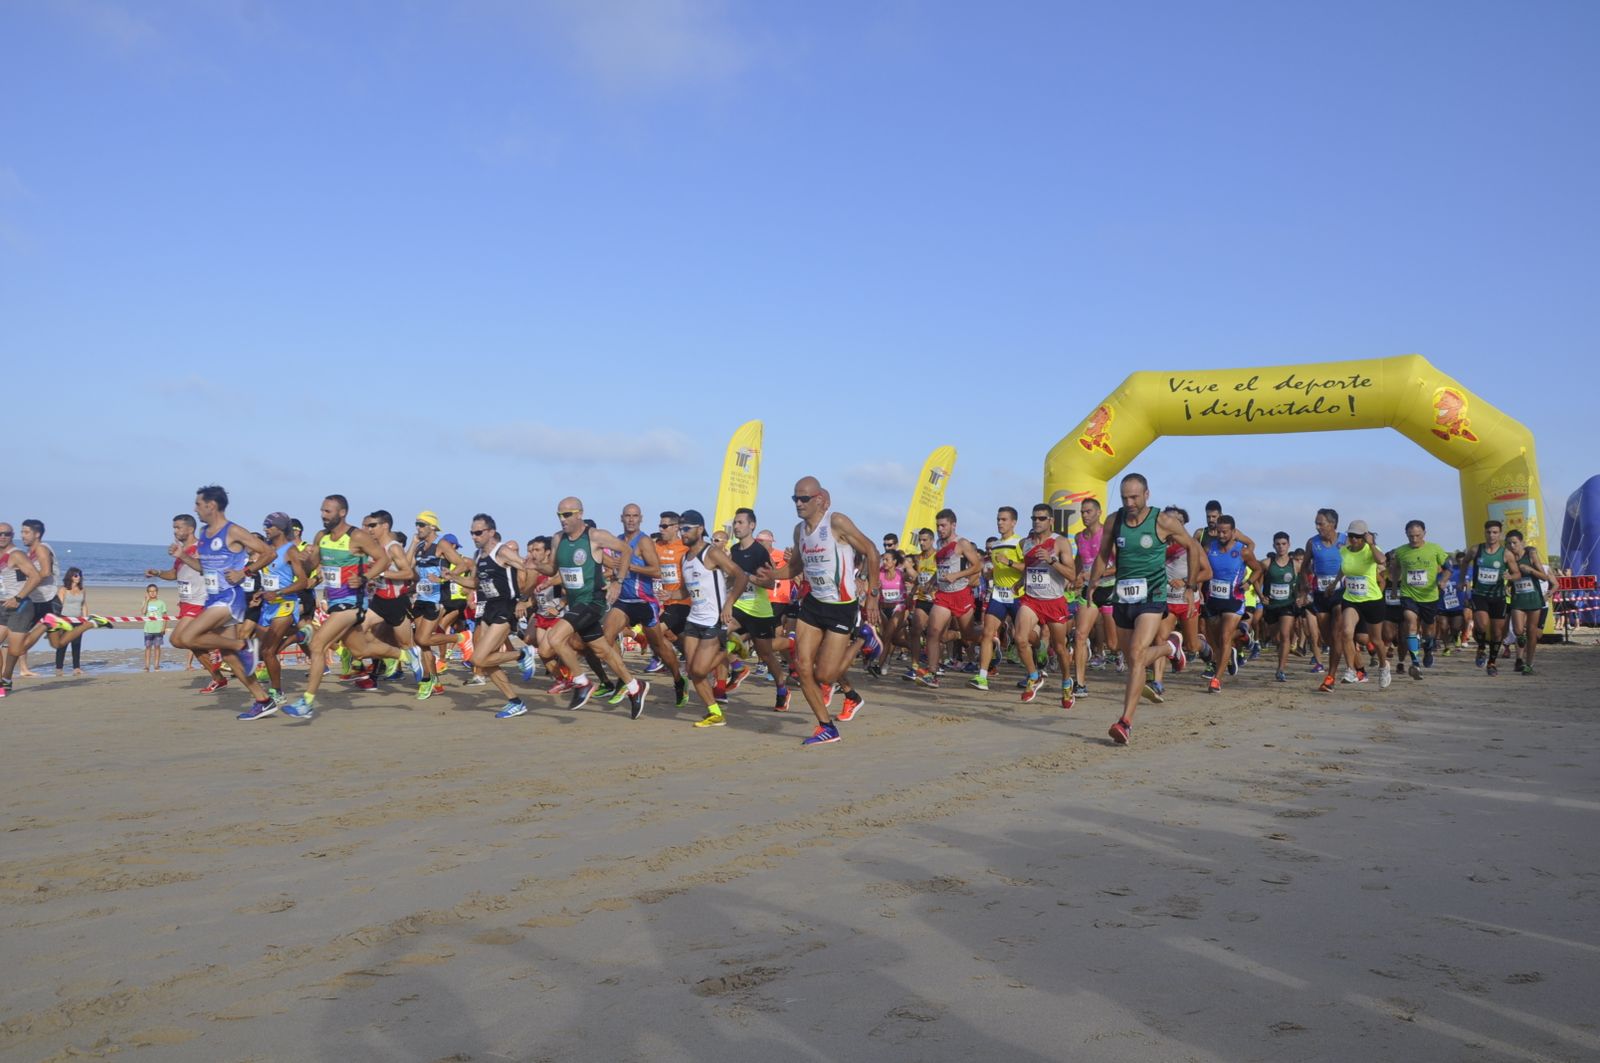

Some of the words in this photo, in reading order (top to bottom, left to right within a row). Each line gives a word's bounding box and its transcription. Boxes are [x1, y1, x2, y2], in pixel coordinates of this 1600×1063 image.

[1169, 377, 1219, 393] Vive
[1233, 376, 1259, 391] el
[1274, 374, 1373, 396] deporte
[1031, 574, 1043, 583] 90
[1123, 586, 1140, 596] 1107
